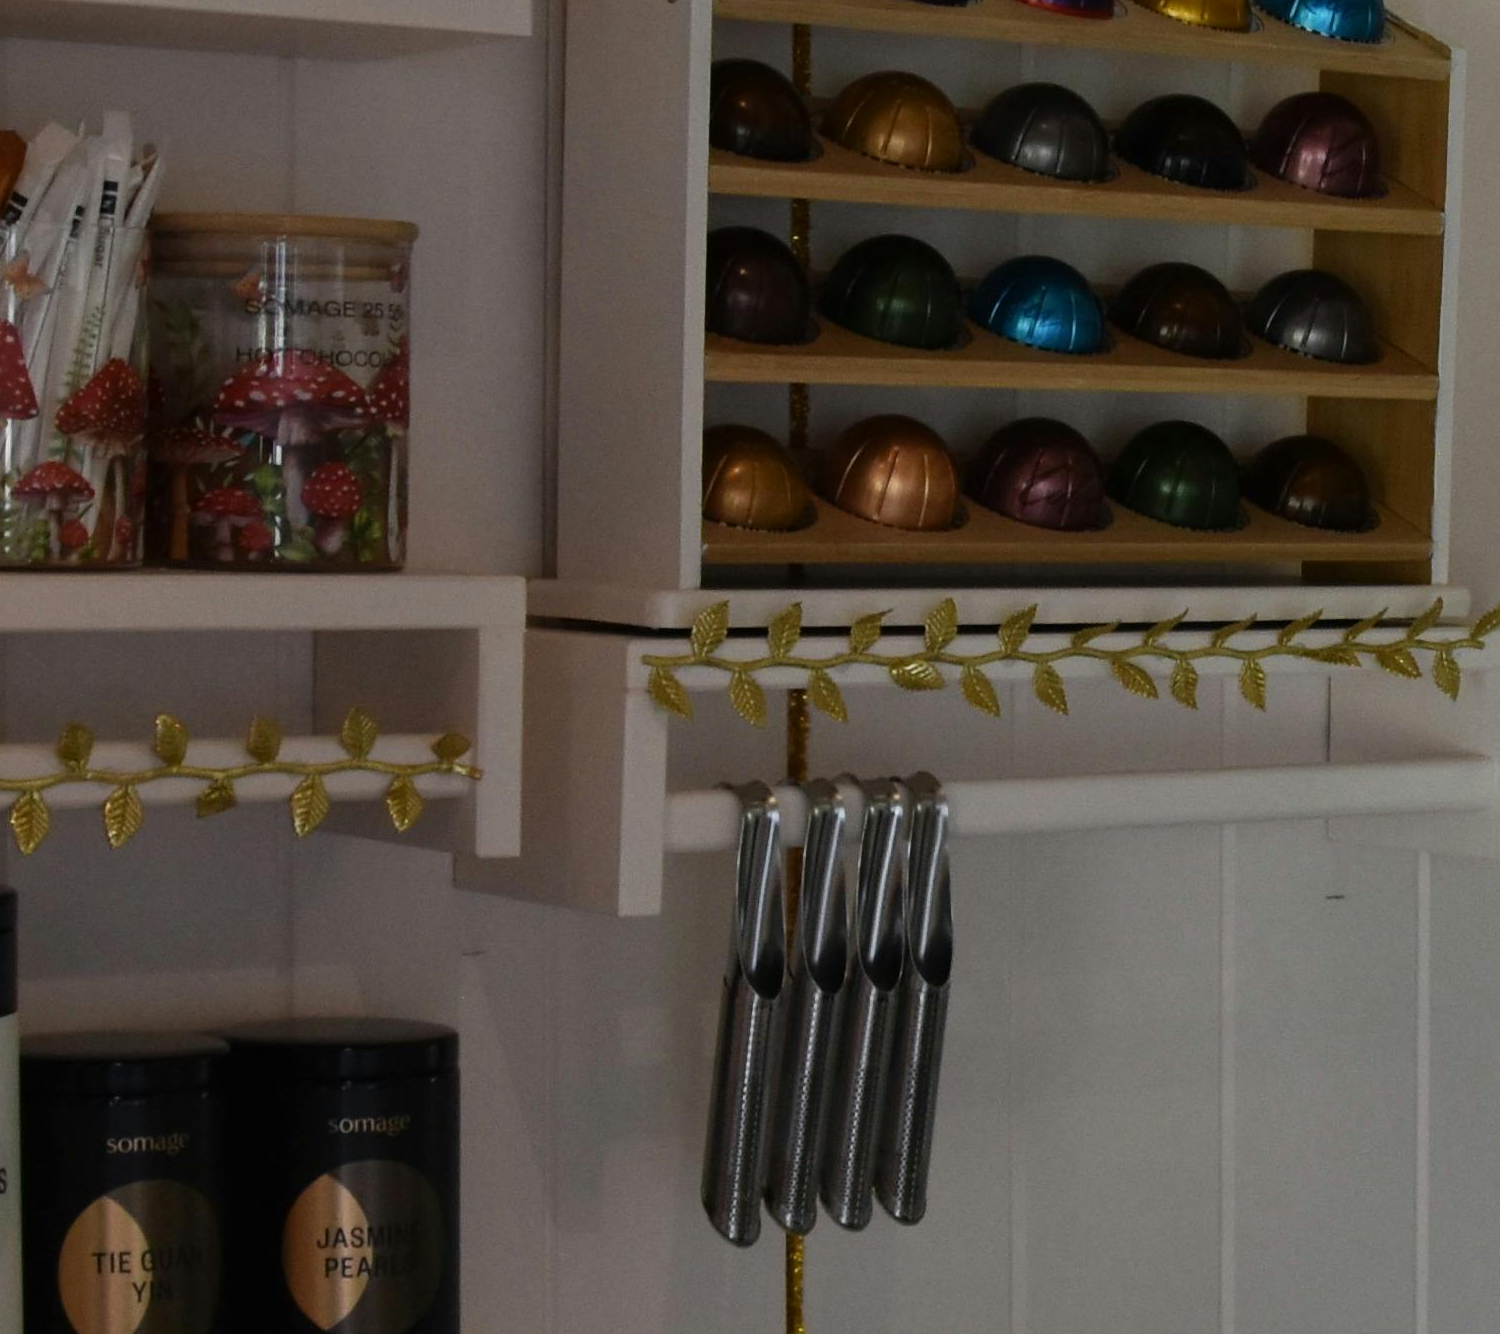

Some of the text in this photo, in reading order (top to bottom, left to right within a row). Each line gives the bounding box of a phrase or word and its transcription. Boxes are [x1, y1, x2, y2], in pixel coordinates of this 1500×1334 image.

[327, 1113, 411, 1137] somage
[106, 1131, 191, 1155] somage
[92, 1244, 206, 1274] TIE GUAN
[132, 1279, 173, 1303] YIN
